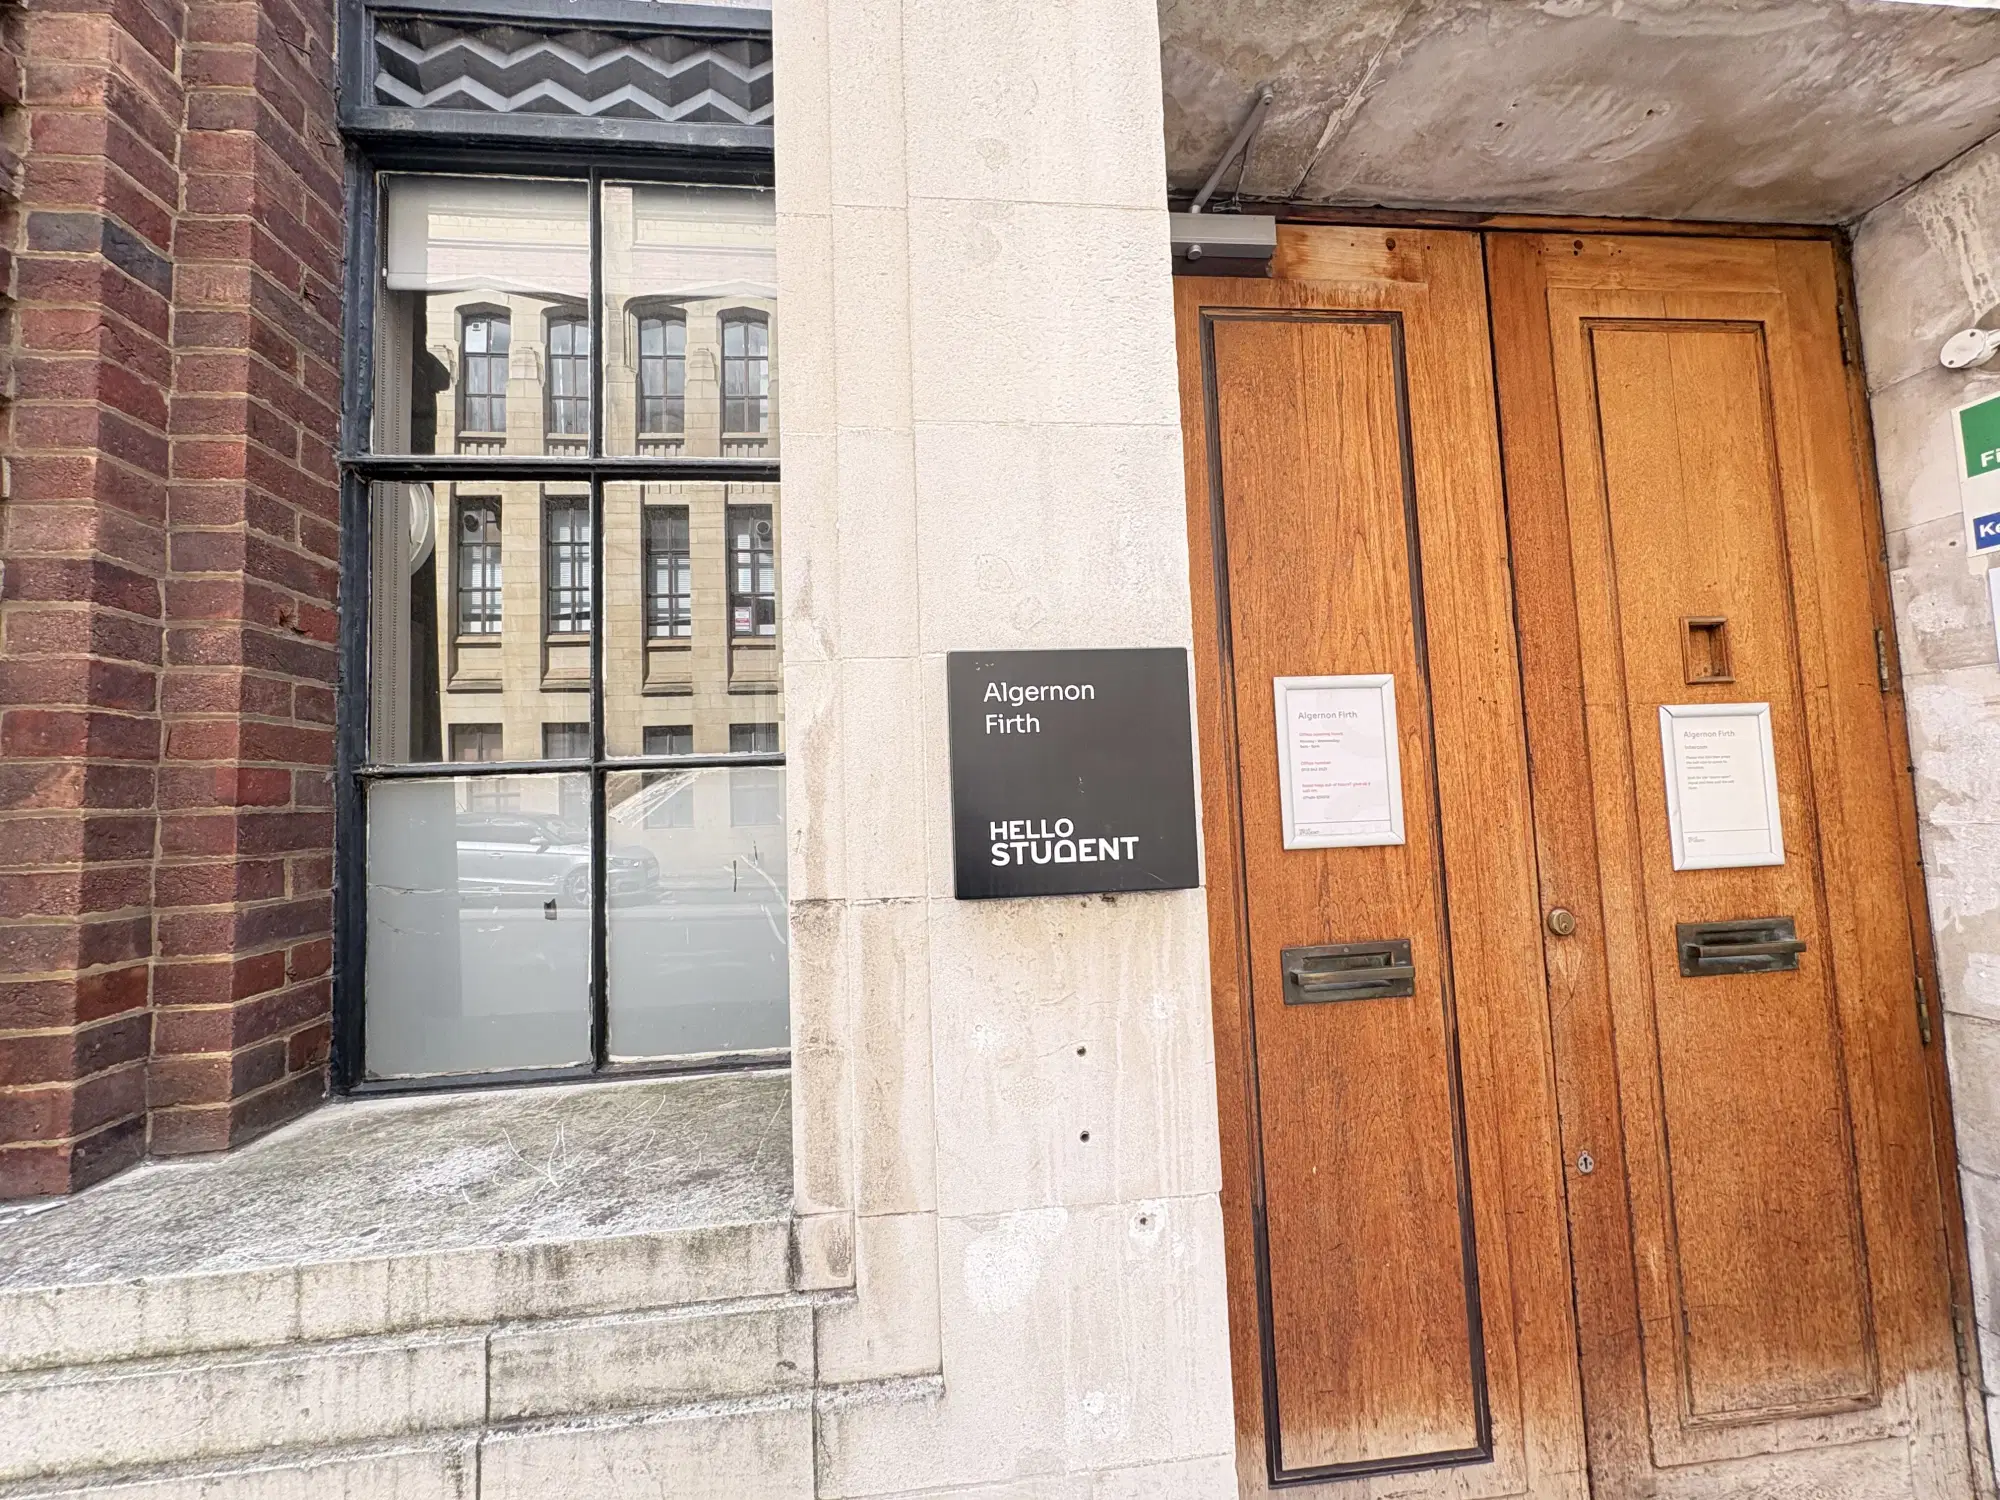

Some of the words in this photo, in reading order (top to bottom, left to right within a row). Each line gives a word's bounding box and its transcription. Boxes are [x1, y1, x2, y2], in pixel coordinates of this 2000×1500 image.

[983, 681, 1095, 707] Algernon
[985, 713, 1041, 734] Firth
[1298, 712, 1337, 721] Algernon
[1338, 711, 1358, 719] Firth
[1684, 731, 1717, 739] Algernon
[990, 818, 1075, 841] HELLO
[991, 836, 1139, 867] STUDENT
